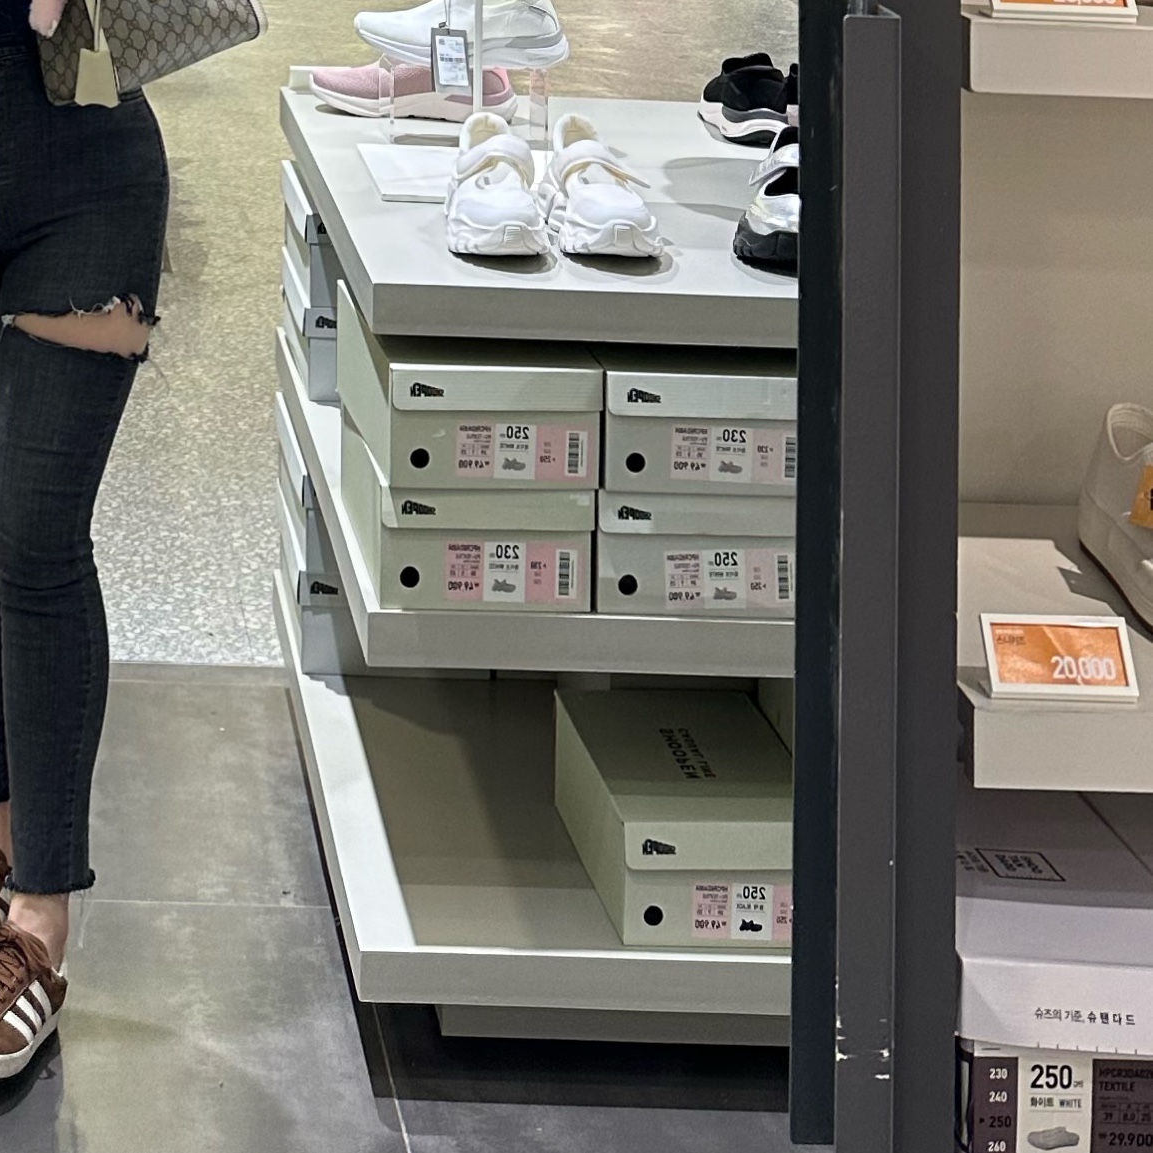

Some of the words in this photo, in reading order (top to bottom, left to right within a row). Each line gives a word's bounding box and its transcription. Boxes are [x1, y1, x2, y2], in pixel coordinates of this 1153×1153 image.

[1051, 655, 1116, 682] 20,000
[1034, 1007, 1062, 1021] 슈즈의
[989, 1068, 1008, 1079] 230
[1030, 1064, 1072, 1089] 250
[1099, 1081, 1135, 1092] TEXTILE
[989, 1091, 1007, 1102] 240
[1030, 1097, 1054, 1107] 화이트
[1059, 1098, 1082, 1109] WHITE
[989, 1115, 1012, 1128] 250
[988, 1141, 1006, 1152] 260
